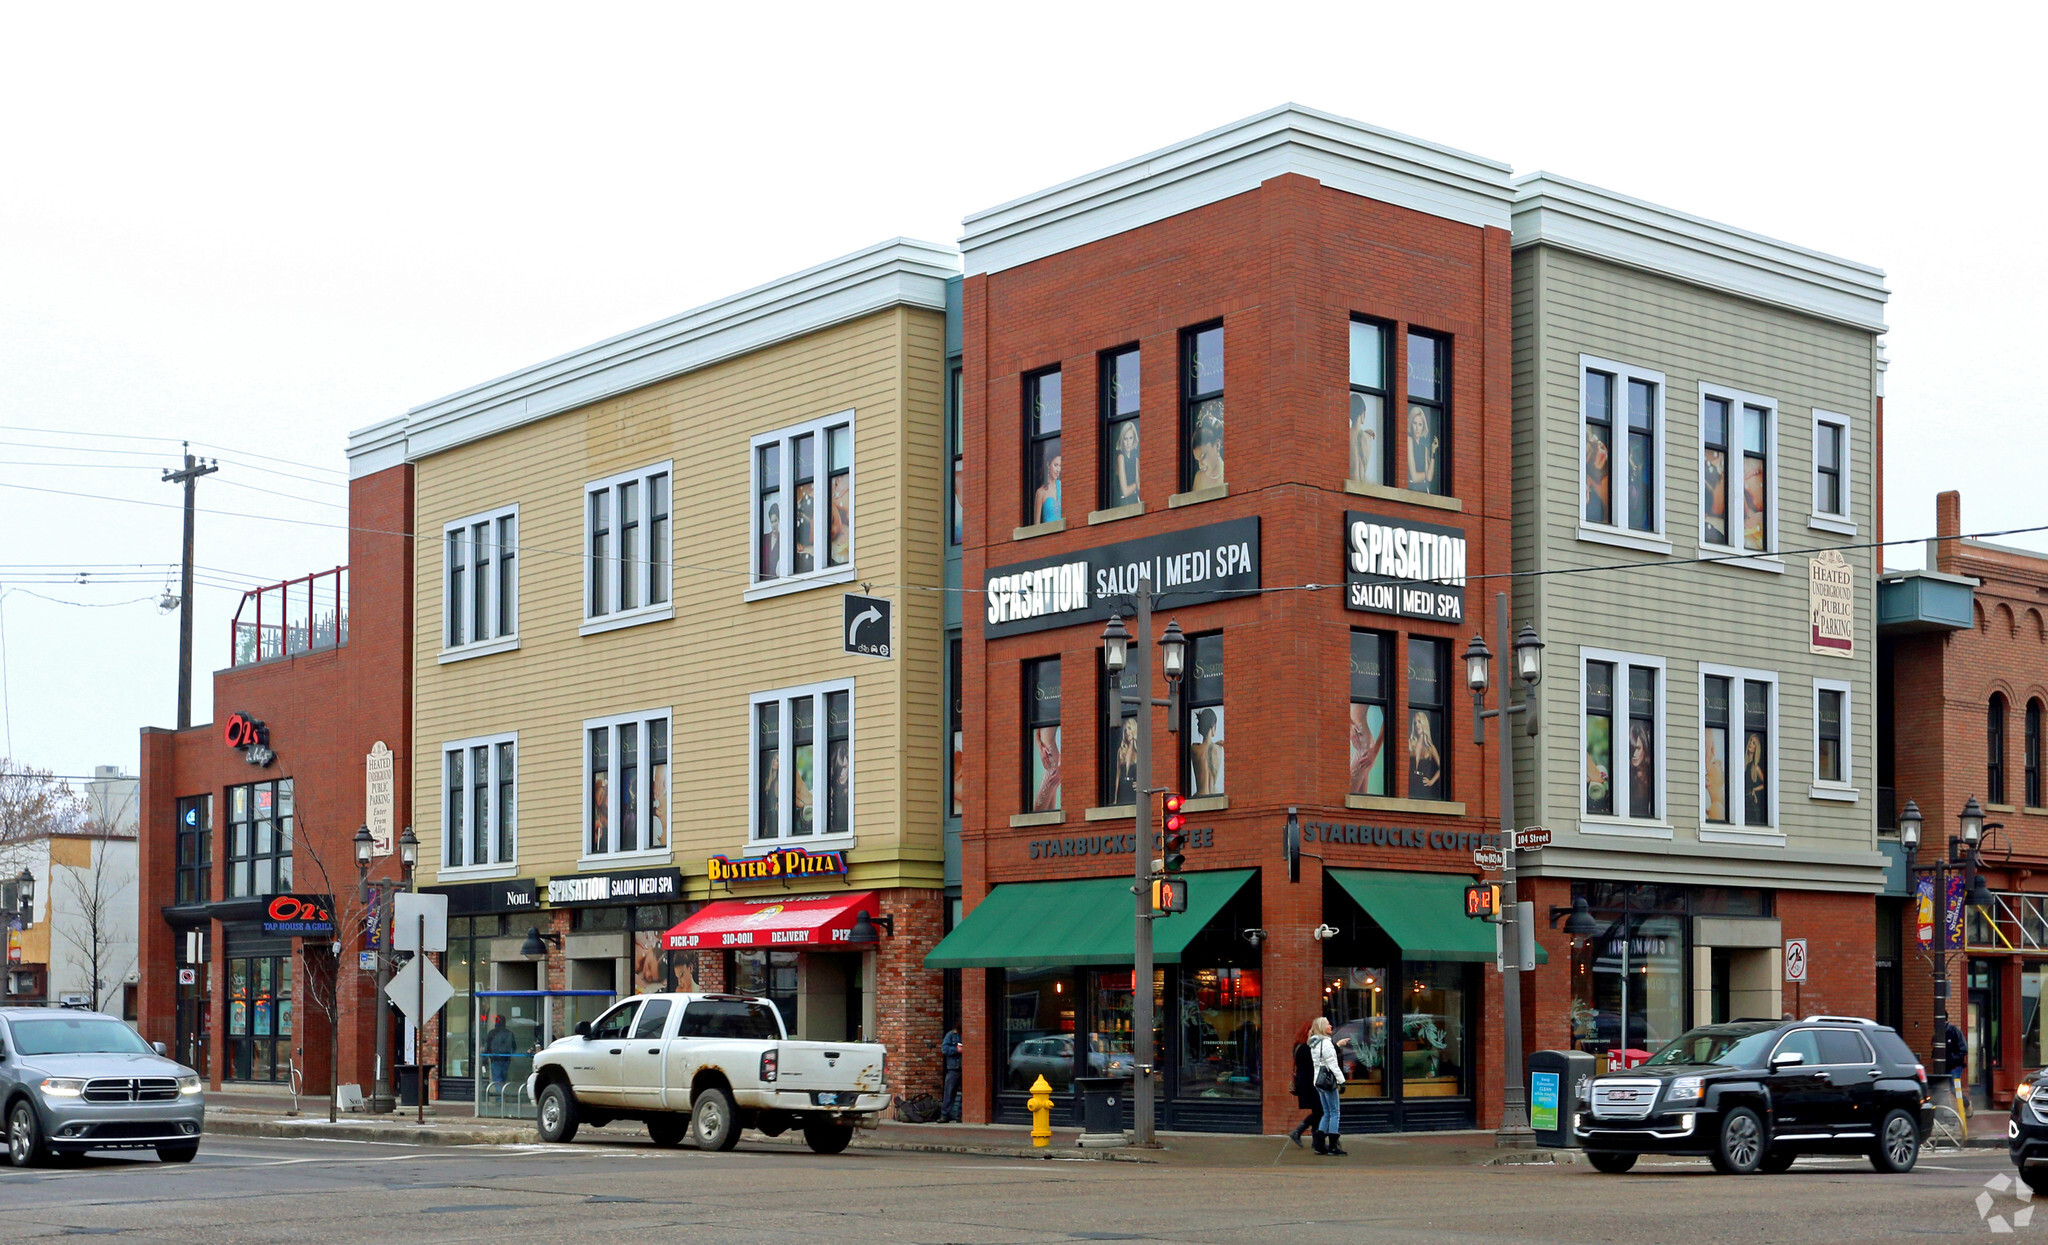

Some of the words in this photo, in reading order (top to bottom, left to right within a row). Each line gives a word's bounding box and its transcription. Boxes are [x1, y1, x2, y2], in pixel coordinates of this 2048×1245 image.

[1351, 521, 1466, 587] SPASATION
[988, 561, 1089, 624] SPASATION
[1097, 561, 1150, 599] SALON
[1166, 549, 1211, 587] MEDI
[1216, 542, 1251, 578] SPA
[1813, 566, 1850, 585] HEATED
[1812, 581, 1851, 600] UNDERGROUND
[1352, 582, 1392, 609] SALON
[1403, 589, 1434, 615] MEDI
[1437, 594, 1461, 619] SPA
[1821, 598, 1850, 616] PUBLIC
[1820, 615, 1851, 637] PARKING
[369, 758, 391, 770] HEATED
[371, 782, 388, 794] PUBLIC
[369, 793, 390, 806] PARKING
[373, 808, 387, 816] Enter
[374, 825, 386, 835] Alley
[1304, 822, 1426, 848] STARBUCKS
[1430, 830, 1502, 851] COFFEE
[1518, 834, 1528, 845] 104
[1529, 833, 1549, 843] Street
[1028, 833, 1136, 859] STARBUCKS
[785, 851, 834, 873] PIZZA
[548, 877, 609, 902] SPASATION
[611, 879, 634, 896] SALON
[639, 877, 657, 894] MEDI
[658, 876, 673, 893] SPA
[268, 896, 328, 921] O2's
[1481, 891, 1490, 908] 12
[1946, 910, 1954, 923] Old
[263, 922, 279, 931] TAP
[279, 922, 304, 931] HOUSE
[305, 922, 311, 930] &
[312, 922, 333, 931] GRILL
[670, 935, 699, 947] PICK-UP
[722, 932, 753, 945] 310-0011
[771, 930, 809, 943] DELIVERY
